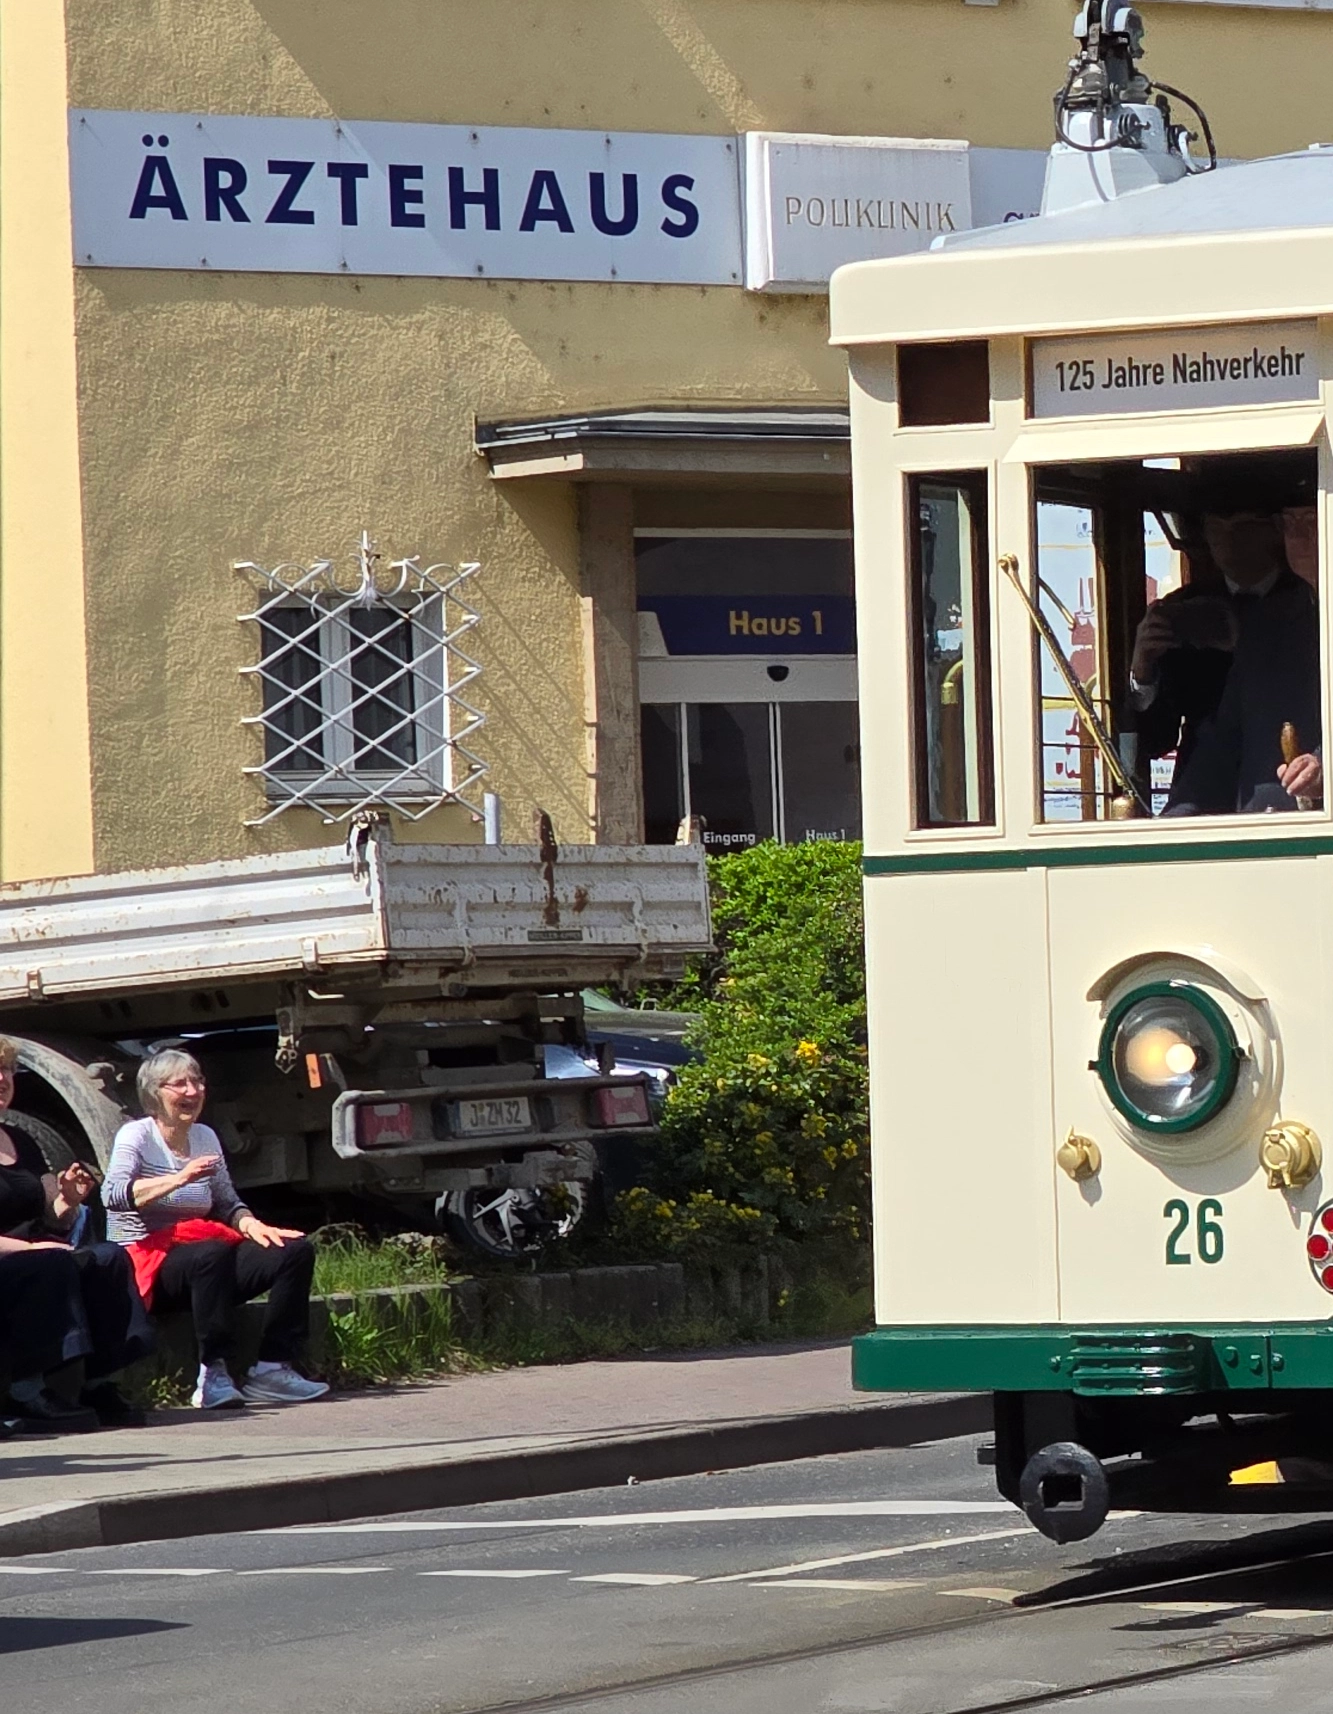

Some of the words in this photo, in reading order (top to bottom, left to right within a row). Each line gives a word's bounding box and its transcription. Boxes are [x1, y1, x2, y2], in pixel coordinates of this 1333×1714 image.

[128, 133, 700, 239] ÄRZTEHAUS
[784, 195, 956, 233] POLIKLINIK
[1055, 359, 1096, 392] 125
[1101, 355, 1165, 389] Jahre
[1172, 346, 1306, 384] Nahverkehr
[728, 610, 802, 636] Haus
[811, 610, 823, 636] 1
[702, 831, 756, 846] Eingang
[805, 828, 838, 841] Haus
[470, 1103, 479, 1127] J
[504, 1100, 522, 1125] 32
[1163, 1198, 1224, 1265] 26
